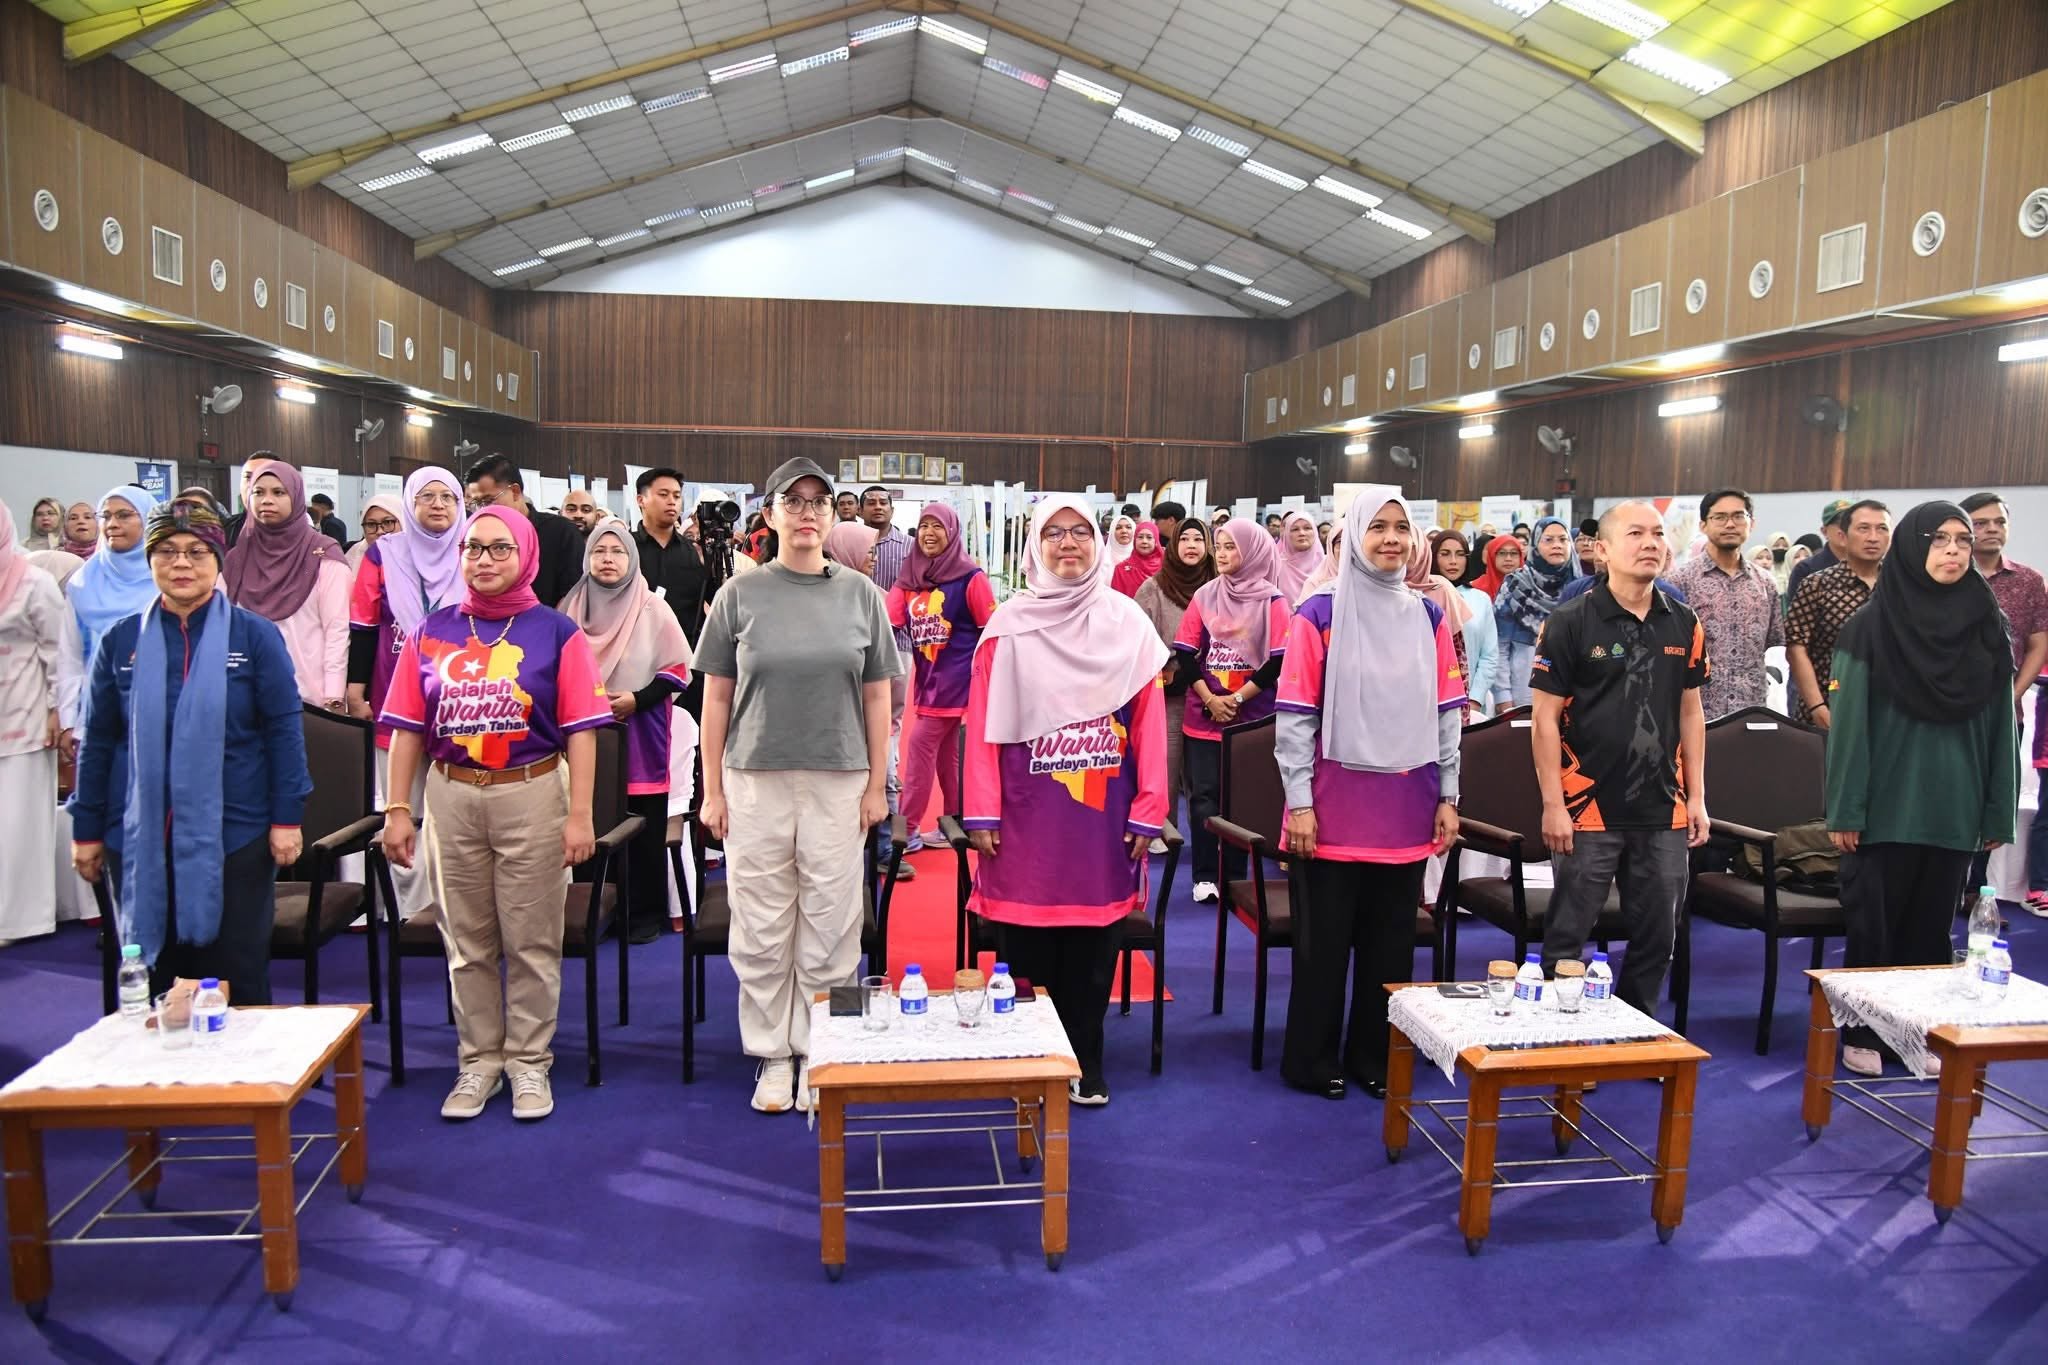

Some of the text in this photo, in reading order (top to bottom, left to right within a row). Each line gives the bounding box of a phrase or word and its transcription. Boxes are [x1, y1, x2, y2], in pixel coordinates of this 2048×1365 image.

[441, 678, 512, 701] Jelajah
[438, 694, 524, 725] Wanita
[439, 723, 487, 737] Brdaya
[1034, 730, 1118, 758] Wanita
[1031, 757, 1089, 773] Berdaya
